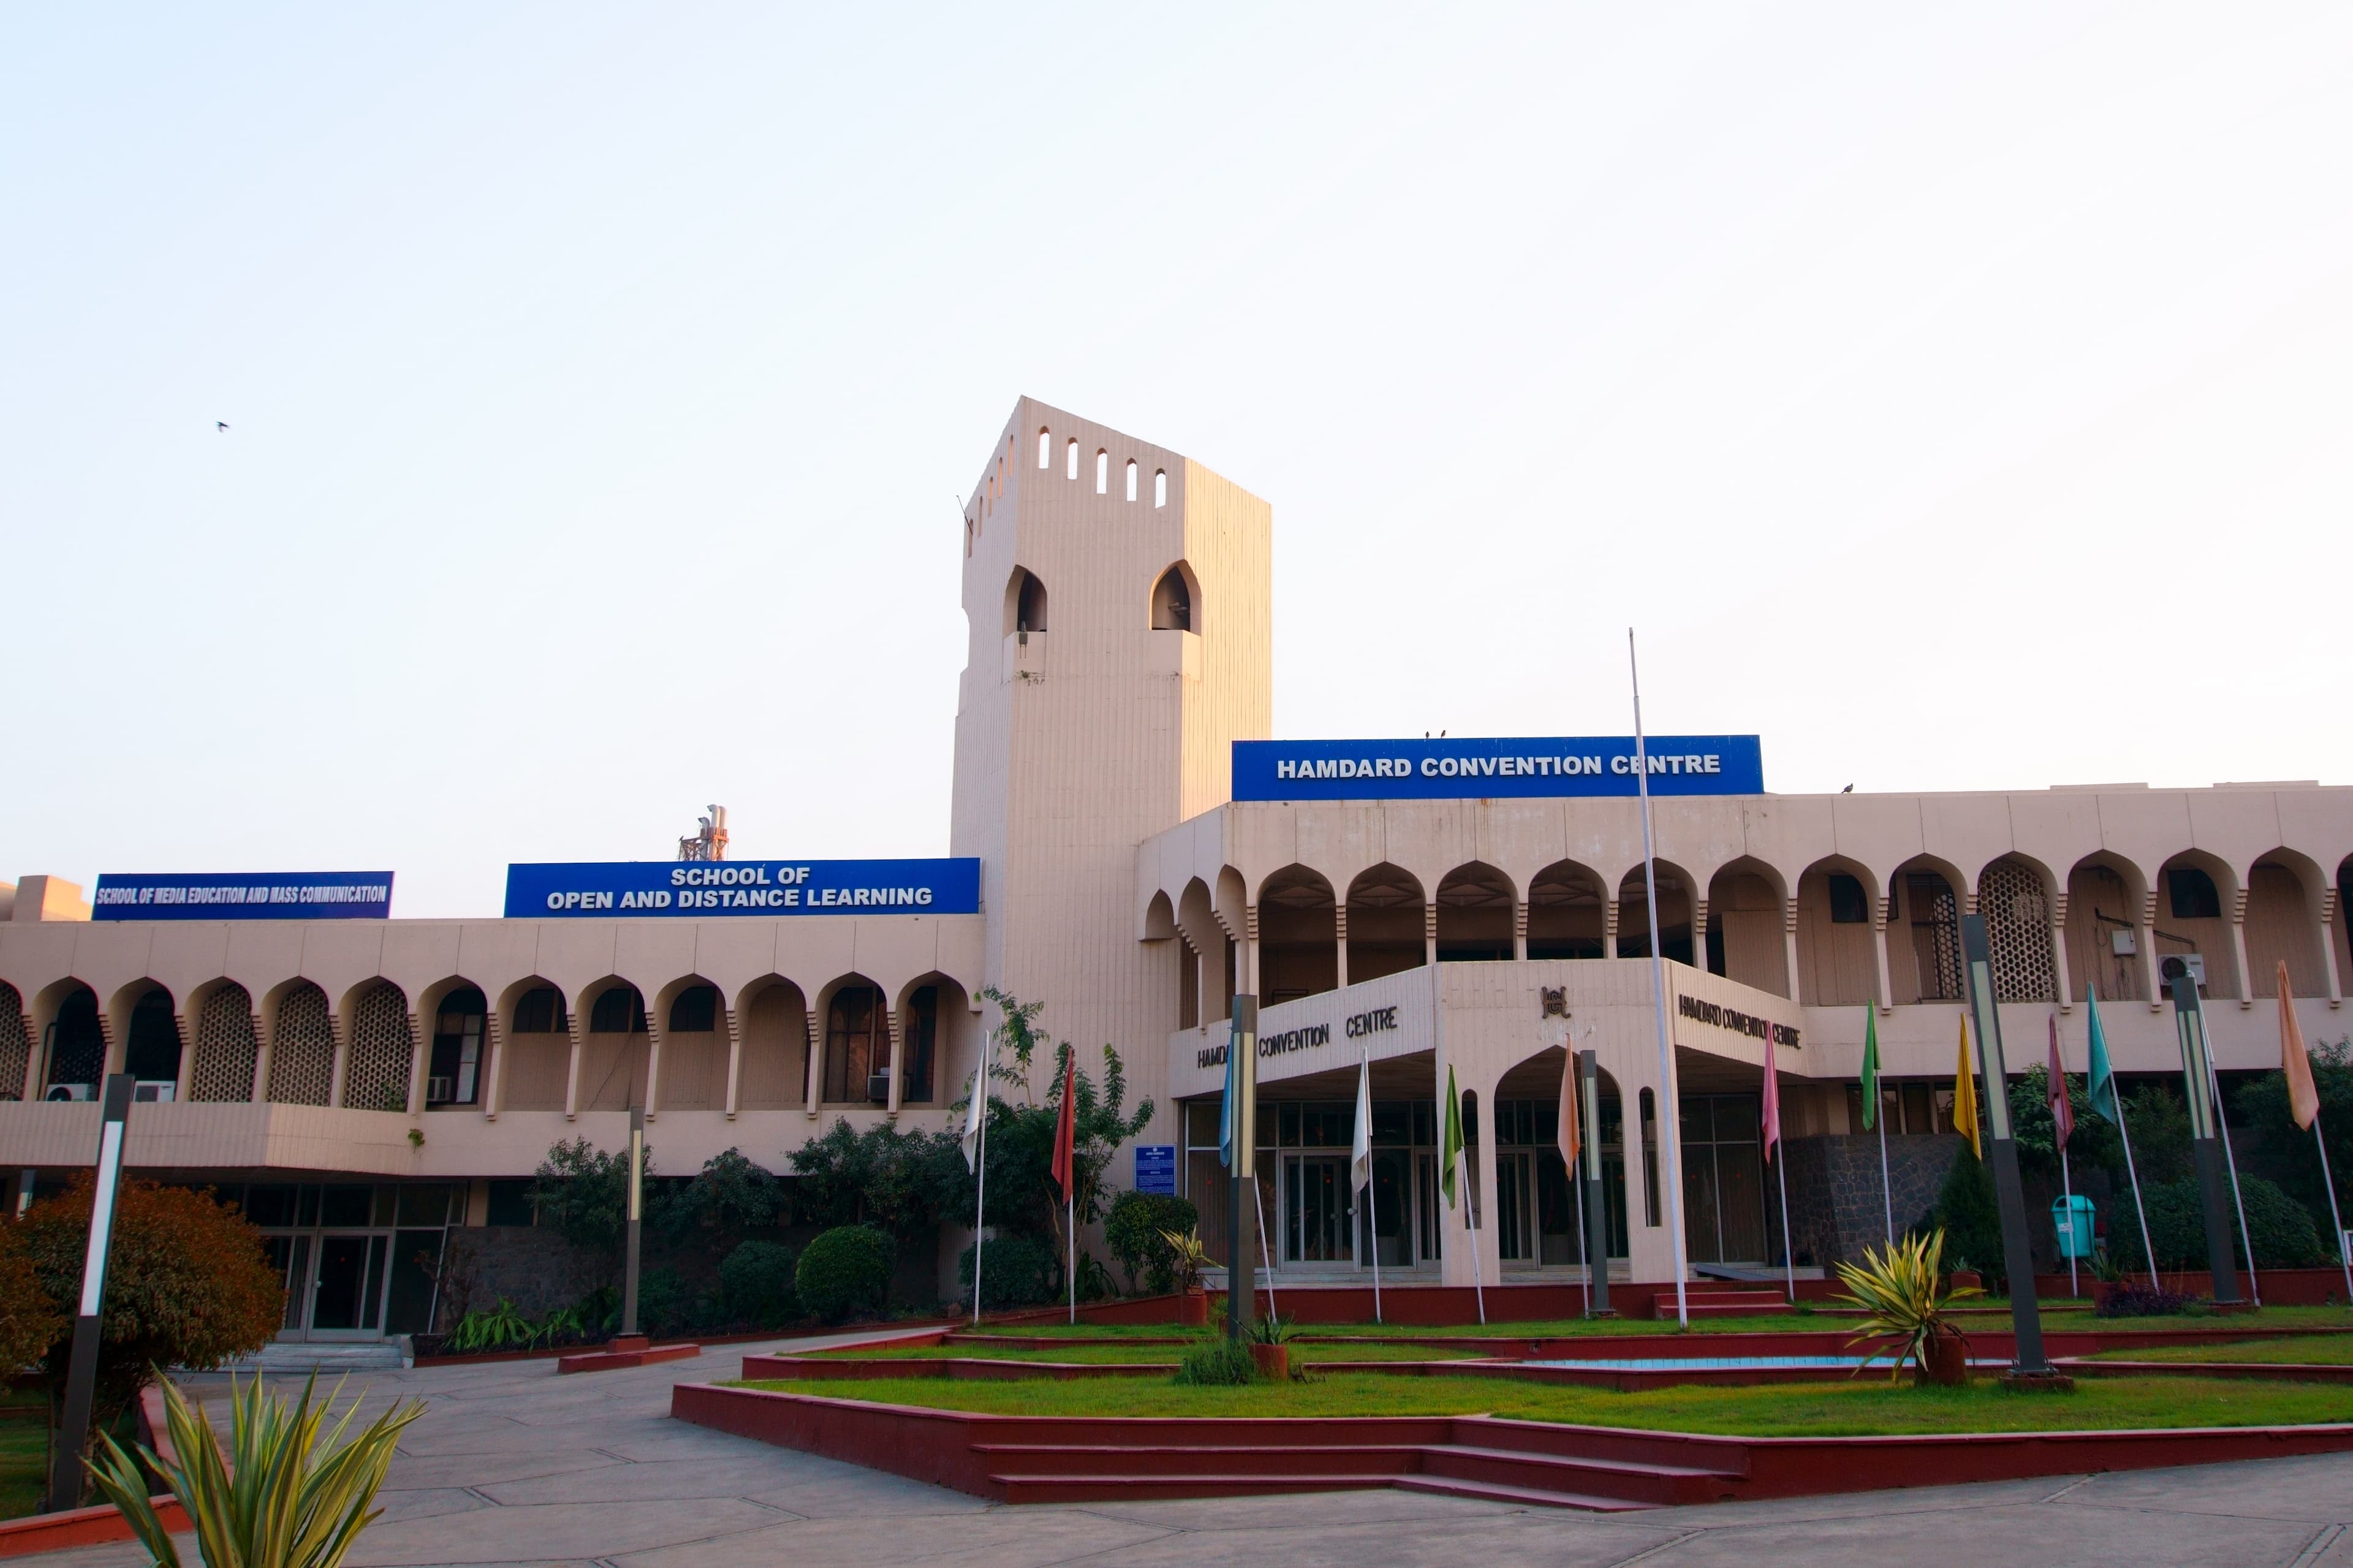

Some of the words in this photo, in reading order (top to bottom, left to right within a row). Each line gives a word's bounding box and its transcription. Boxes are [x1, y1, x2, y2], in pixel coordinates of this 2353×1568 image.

[1277, 759, 1412, 779] HAMDARD
[1420, 756, 1602, 777] CONVENTION
[1610, 754, 1721, 775] CENTRE
[671, 868, 770, 886] SCHOOL
[778, 867, 810, 884] OF
[96, 888, 137, 904] SCHOOL
[138, 888, 154, 904] OF
[154, 888, 186, 904] MEDIA
[187, 887, 246, 904] EDUCATION
[246, 887, 268, 903] AND
[269, 887, 298, 903] MASS
[299, 886, 387, 903] COMMUNICATION
[547, 893, 613, 910] OPEN
[620, 891, 672, 908] AND
[678, 890, 800, 907] DISTANCE
[807, 888, 933, 906] LEARNING
[1679, 993, 1721, 1027] HAMDARD
[1772, 1023, 1802, 1050] CENTRE
[1197, 1045, 1229, 1069] HAMD
[1259, 1023, 1329, 1057] CONVENTION
[1346, 1006, 1398, 1038] CENTRE
